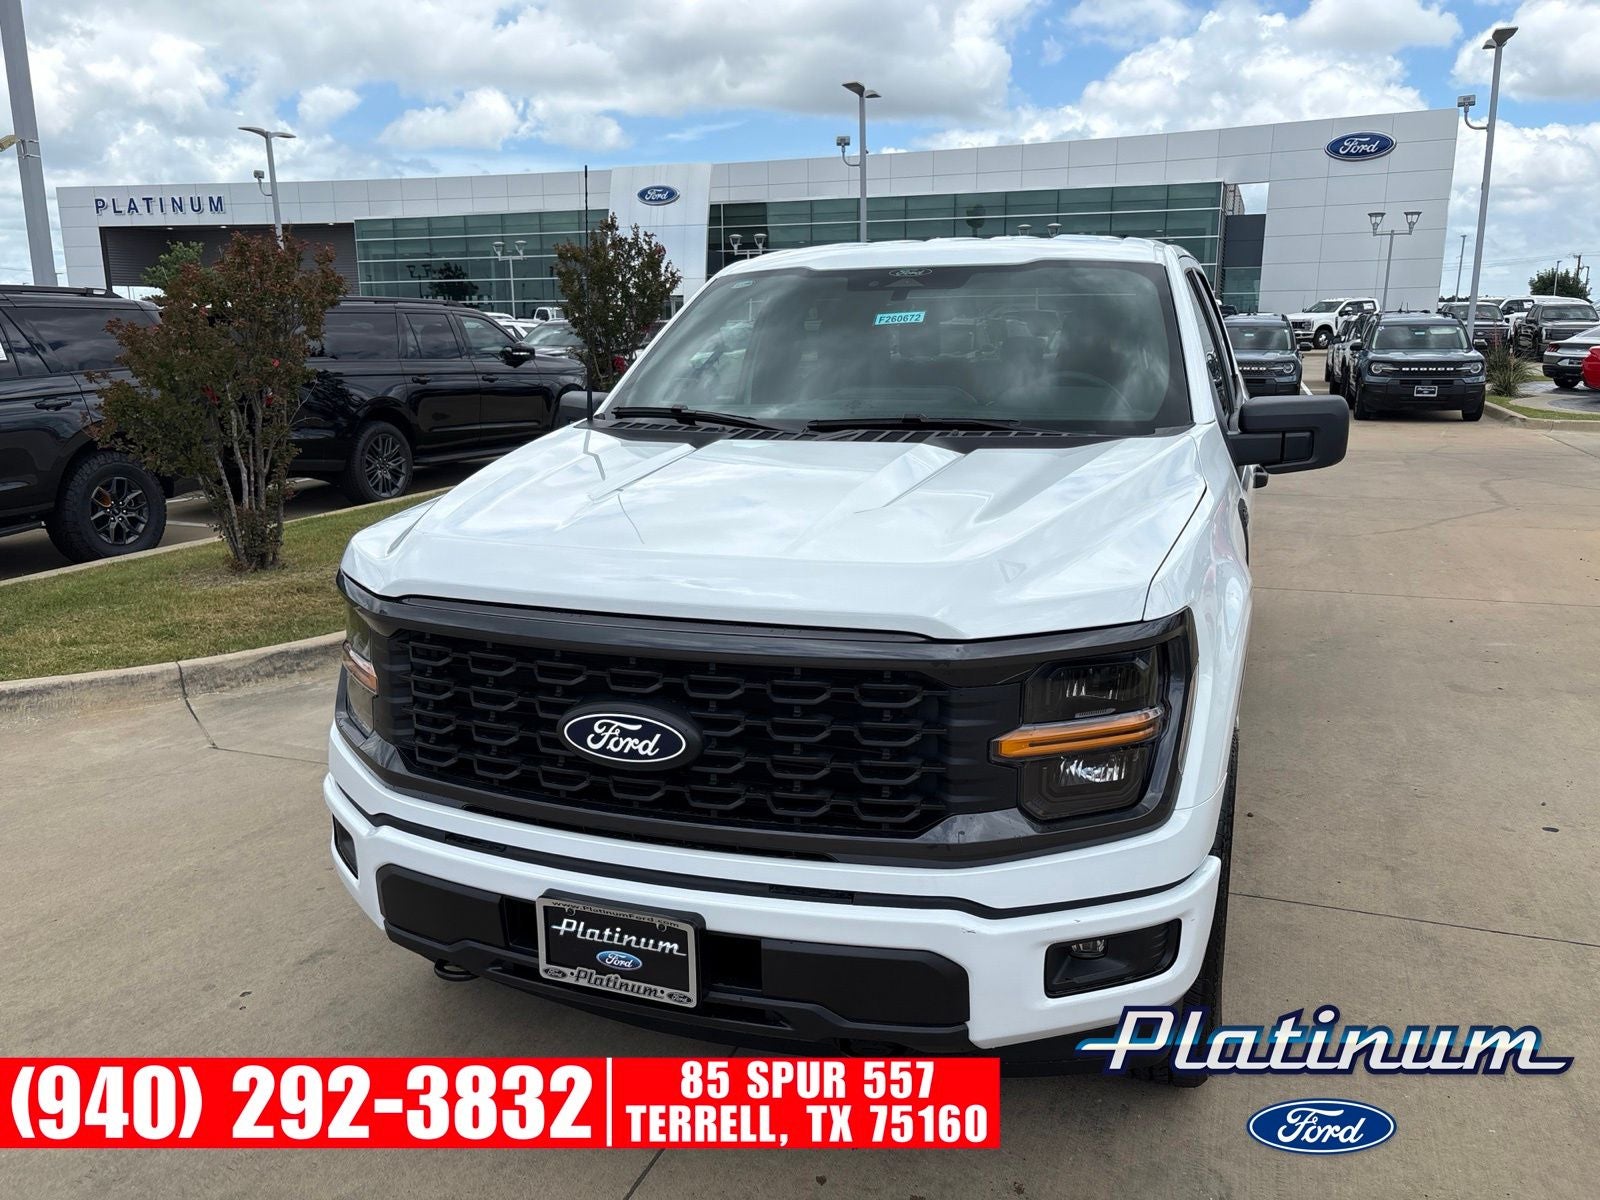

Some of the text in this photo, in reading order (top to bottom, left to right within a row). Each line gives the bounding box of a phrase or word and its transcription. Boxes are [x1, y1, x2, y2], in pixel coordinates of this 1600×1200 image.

[1339, 137, 1379, 154] Ford
[645, 188, 669, 200] Ford
[94, 195, 224, 214] PLATINUM
[878, 314, 921, 323] F260672
[586, 719, 661, 756] Ford
[551, 918, 687, 957] Platinum
[605, 953, 633, 968] Ford
[575, 969, 664, 999] Platinum
